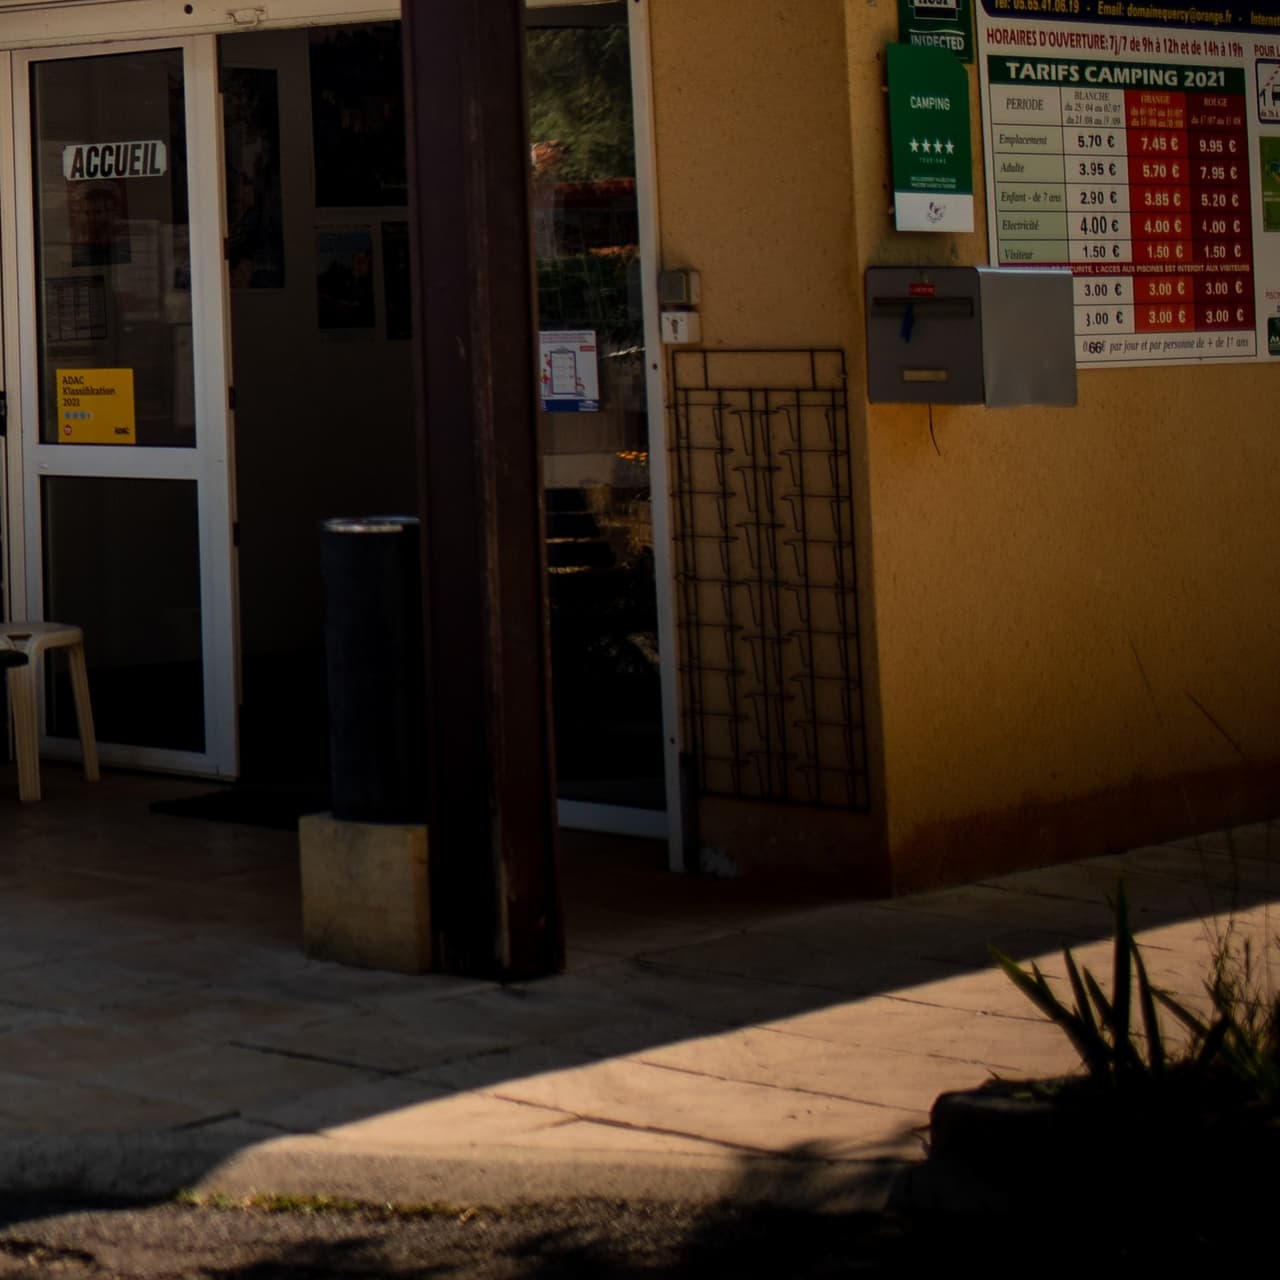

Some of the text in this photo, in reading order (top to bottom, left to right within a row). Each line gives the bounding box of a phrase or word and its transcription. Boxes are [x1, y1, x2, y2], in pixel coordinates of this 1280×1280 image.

[1097, 0, 1125, 17] Email:
[987, 27, 1038, 46] HORAIRES
[1039, 30, 1109, 51] D'OUVERTURE:
[1109, 34, 1128, 56] 7j/7
[1129, 38, 1141, 52] de
[1142, 37, 1154, 52] 9h
[1163, 37, 1180, 54] 12h
[1180, 40, 1191, 56] et
[1191, 40, 1201, 56] de
[1203, 40, 1220, 57] 14h
[1227, 41, 1244, 58] 19h
[1254, 44, 1276, 57] POUR
[1005, 61, 1226, 88] TARIFS CAMPING 2021
[910, 94, 951, 111] CAMPING
[1006, 97, 1044, 112] PERIODE
[999, 133, 1237, 153] Emplacement 5.70 € 7.45 € 9.95 €
[70, 142, 161, 179] ACCUEIL
[1000, 162, 1238, 180] Adulte 3.95 € 5.70 € 7.95 €
[1001, 191, 1026, 204] Enfant
[1033, 192, 1041, 202] de
[1049, 194, 1062, 203] ans
[1080, 191, 1104, 205] 2.90
[1110, 191, 1117, 205] €
[1144, 192, 1169, 207] 3.85
[1173, 193, 1181, 207] €
[1201, 193, 1226, 207] 5.20
[1231, 193, 1240, 207] €
[1080, 216, 1107, 235] 4.00
[1111, 220, 1119, 233] €
[1143, 219, 1169, 234] 4.00
[1174, 219, 1182, 233] €
[1202, 220, 1226, 234] 4.00
[1233, 219, 1241, 233] €
[1005, 244, 1242, 260] Visiteur 1.50 € 1.50 € 1.50 €
[1121, 264, 1134, 273] AUX
[1136, 264, 1164, 274] PISCINES
[1165, 264, 1176, 273] EST
[1177, 264, 1205, 273] INTERDIT
[1205, 263, 1219, 273] AUX
[1220, 263, 1250, 273] VISITEURS
[1084, 281, 1243, 297] 3.00 € 3.00 € 3.00 €
[1115, 311, 1124, 325] €
[1148, 311, 1172, 325] 3.00
[1178, 310, 1186, 324] €
[1205, 309, 1229, 324] 3.00
[1235, 308, 1244, 321] €
[1109, 341, 1122, 352] par
[1122, 339, 1139, 354] jour
[1141, 339, 1149, 349] et
[1149, 340, 1162, 352] par
[1162, 338, 1195, 352] personne
[1196, 336, 1204, 348] de
[1215, 335, 1225, 348] de
[1235, 338, 1249, 347] ans
[62, 375, 85, 385] ADAC
[62, 385, 116, 396] Klassifikation
